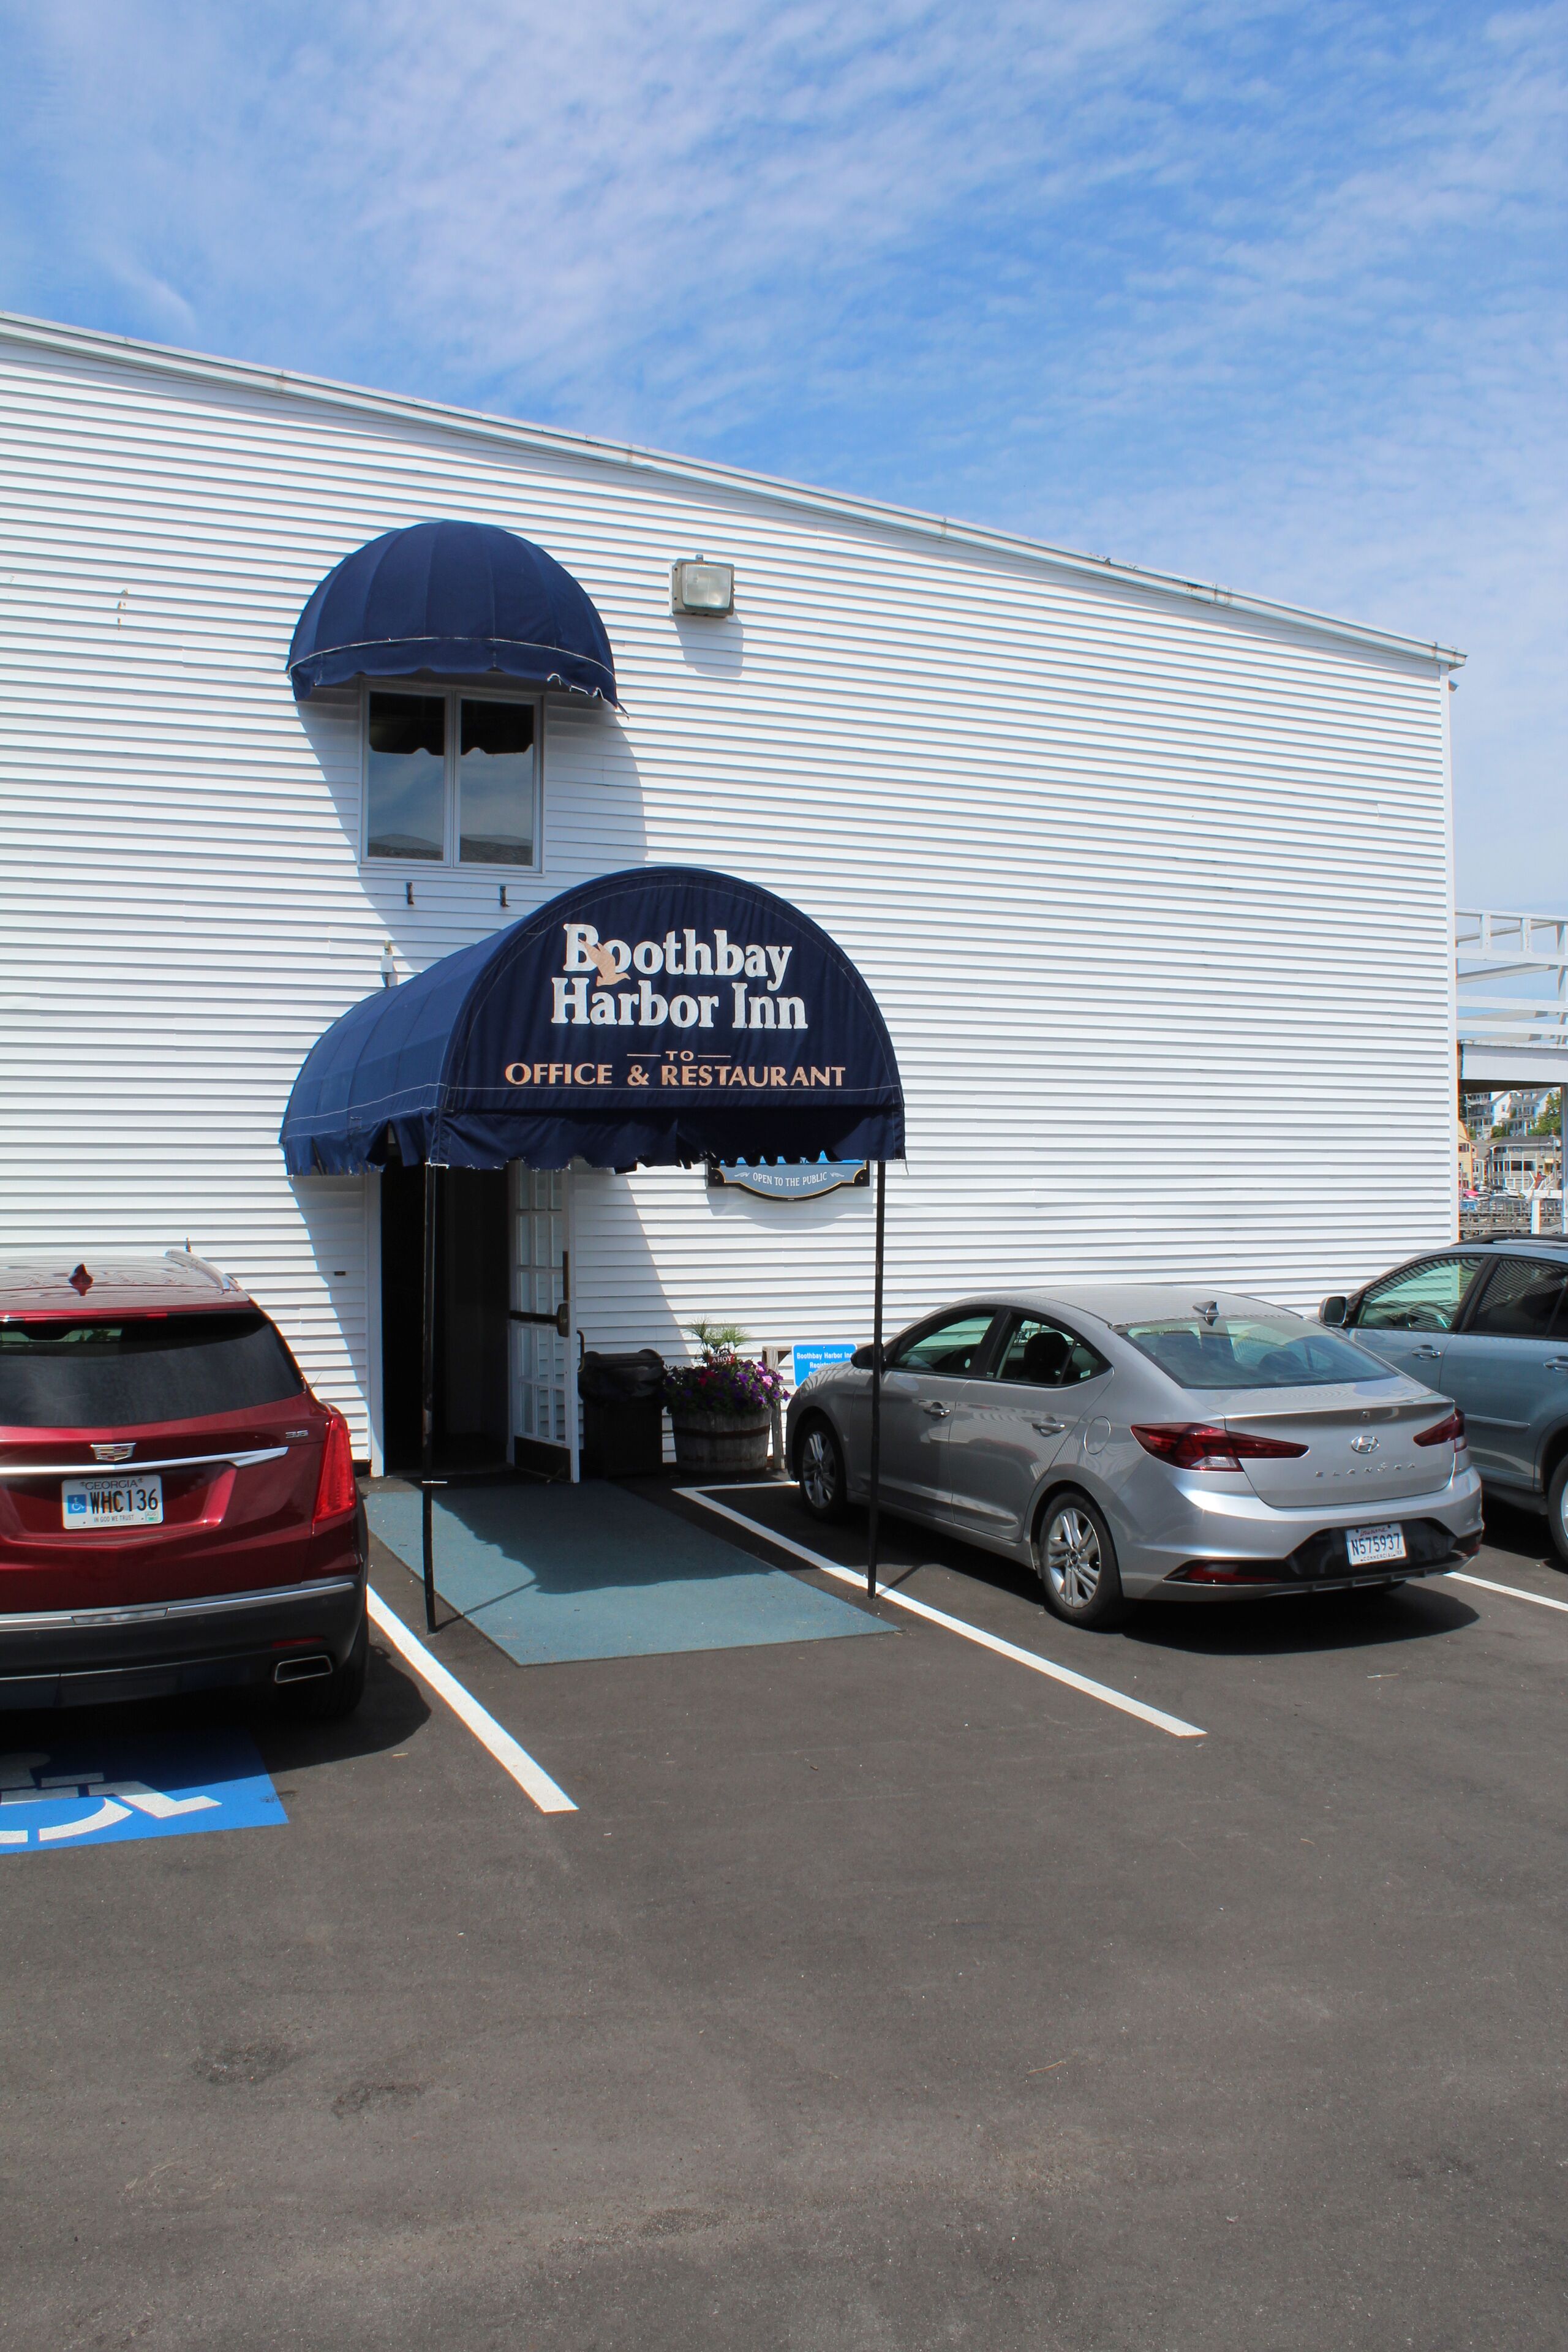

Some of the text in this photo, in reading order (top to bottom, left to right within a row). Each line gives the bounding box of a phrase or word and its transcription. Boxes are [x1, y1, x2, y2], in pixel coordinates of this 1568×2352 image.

[563, 923, 793, 991] Boothbay
[551, 977, 809, 1030] Harbor Inn
[665, 1050, 695, 1061] TO
[505, 1062, 846, 1087] OFFICE & RESTAURANT
[753, 1172, 827, 1186] OPEN TO THE PUBLIC
[796, 1352, 823, 1360] Boothbay
[85, 1479, 138, 1490] GEORGIA
[89, 1488, 159, 1515] WHC136
[1351, 1532, 1400, 1556] N575937
[1362, 1553, 1393, 1561] COMMERCIAL
